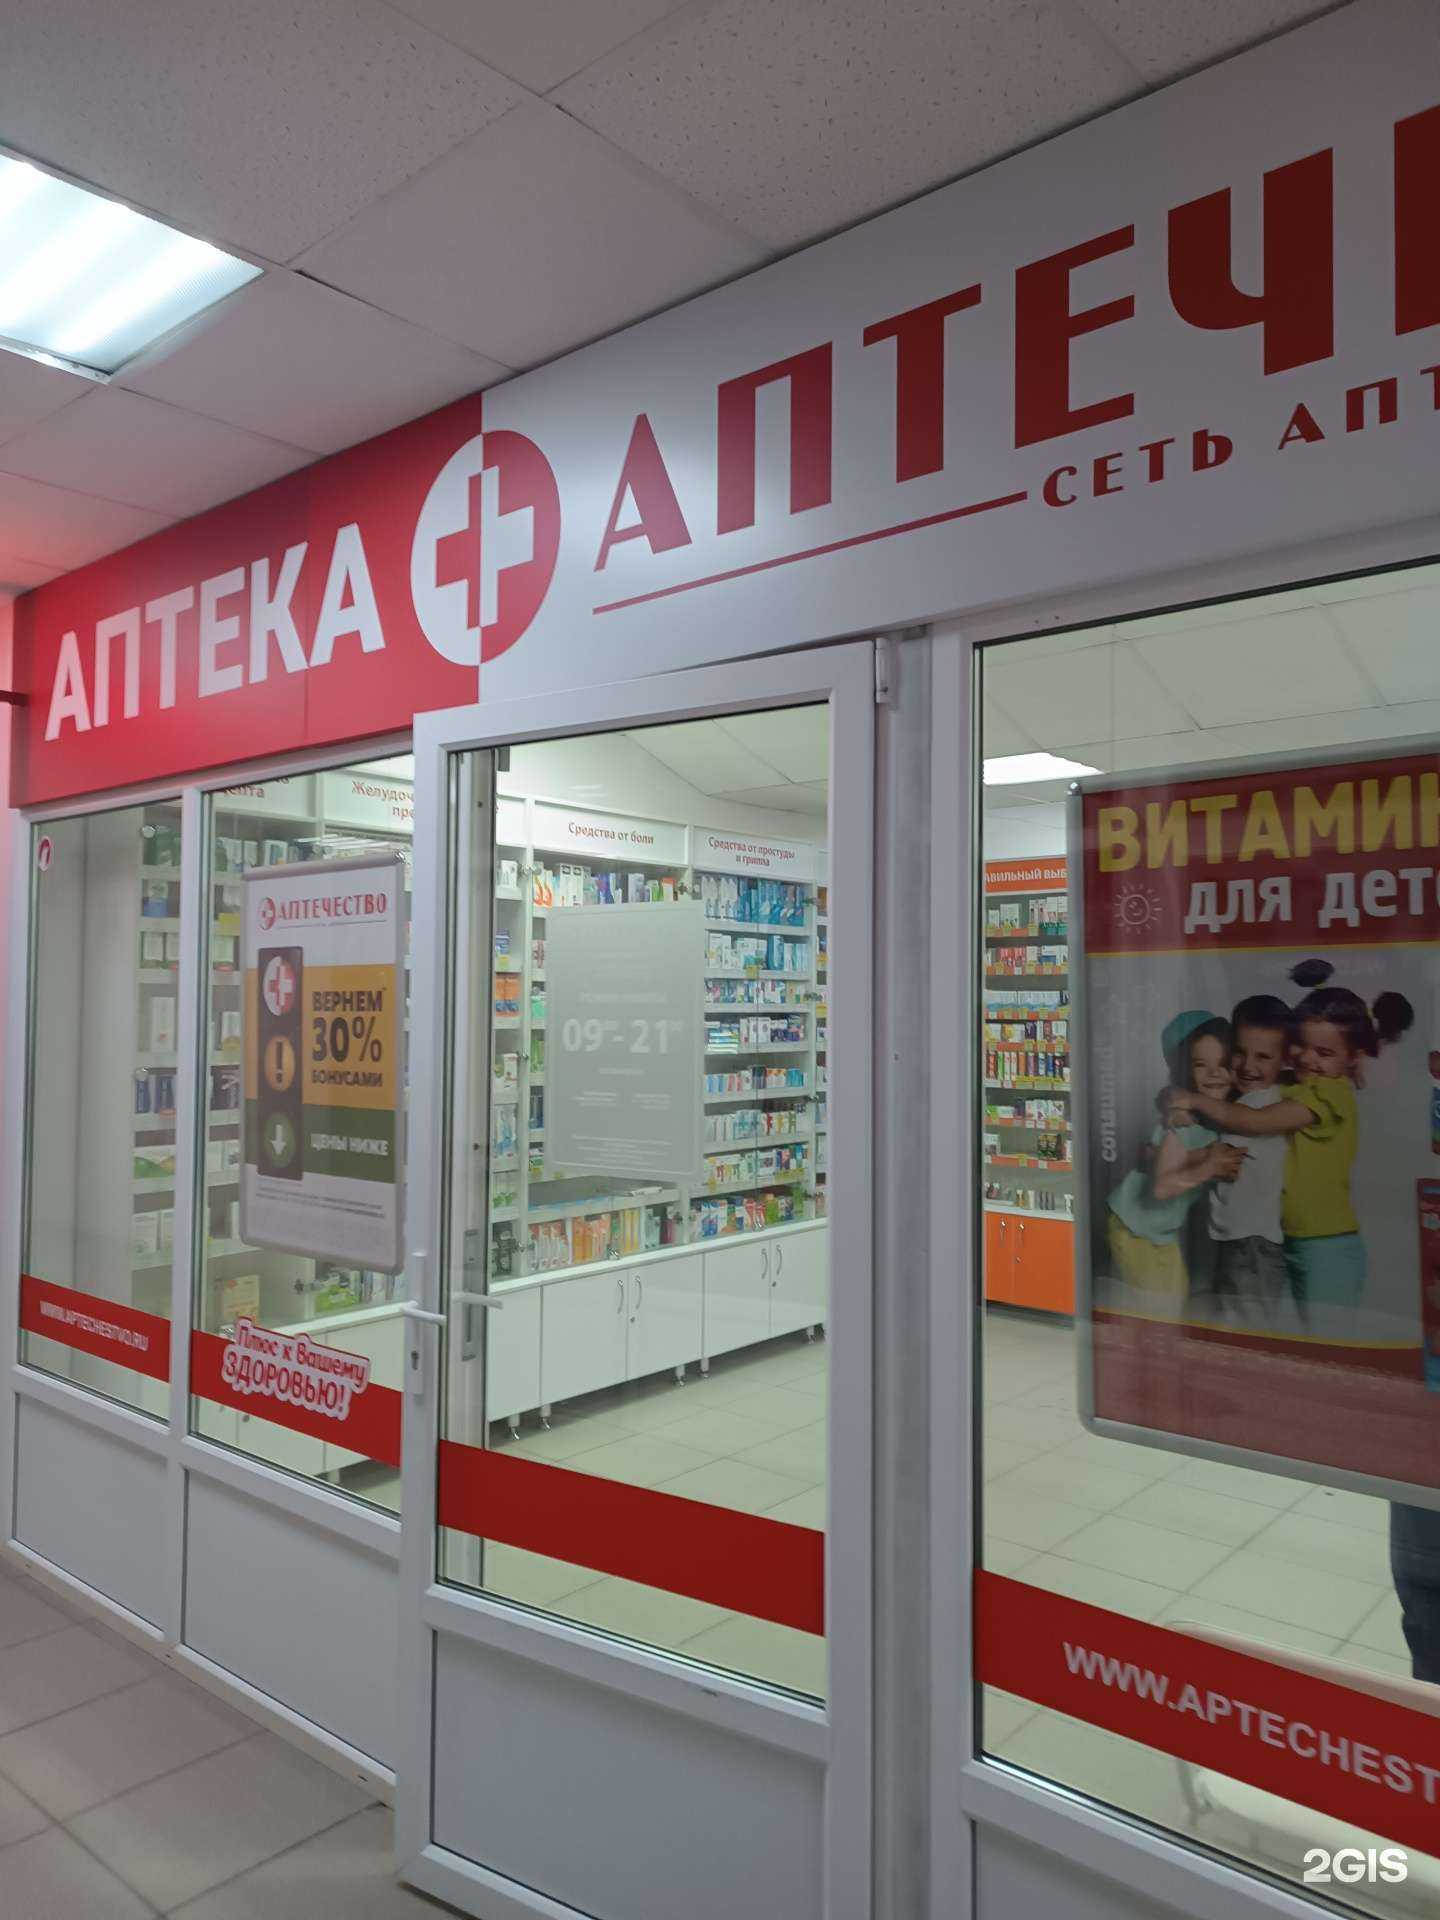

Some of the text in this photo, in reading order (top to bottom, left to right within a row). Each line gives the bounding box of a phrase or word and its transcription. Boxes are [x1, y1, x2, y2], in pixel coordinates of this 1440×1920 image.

[594, 104, 1440, 572] АПТЕЧ
[1042, 428, 1234, 508] СЕТЬ
[45, 522, 386, 741] АПТЕКА
[568, 822, 655, 845] Средства от боли
[708, 836, 796, 860] Средства от простуды
[743, 854, 770, 867] гриппа
[279, 893, 387, 921] АПТЕЧЕСТВО
[1184, 866, 1440, 934] для дет
[312, 1016, 382, 1062] 30%
[311, 1069, 384, 1088] БОНУСАМИ
[225, 1351, 345, 1413] ЗДОРОВЬЮ!
[240, 1325, 366, 1388] Плюс к Вашему
